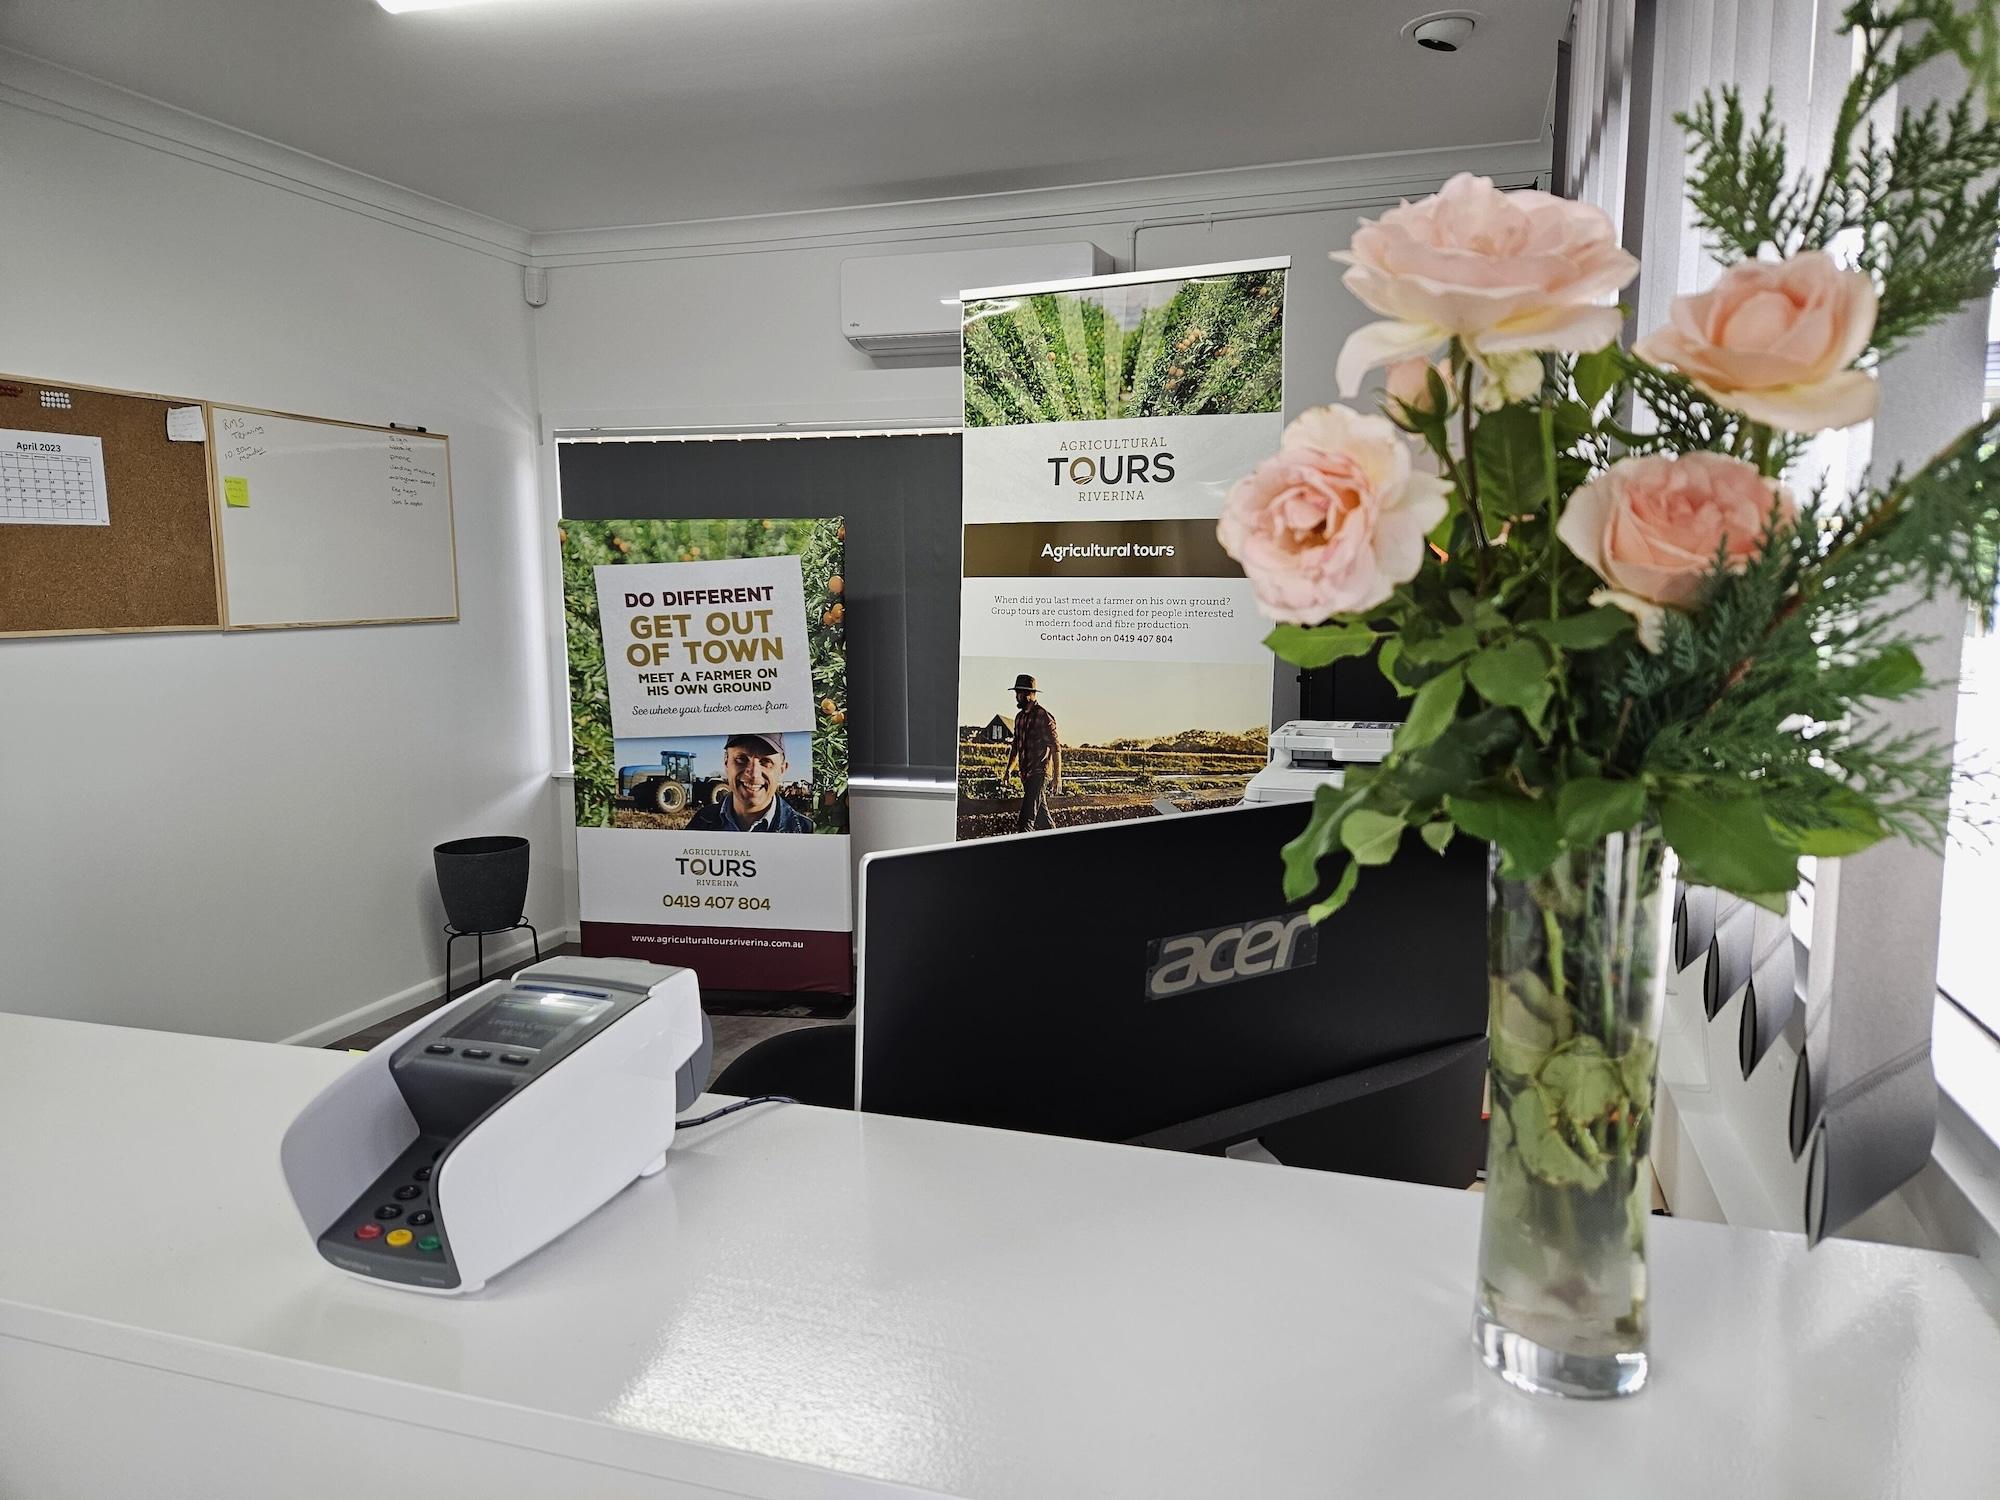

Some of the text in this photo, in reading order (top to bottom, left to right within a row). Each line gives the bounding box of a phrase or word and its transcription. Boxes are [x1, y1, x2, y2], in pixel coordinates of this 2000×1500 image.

[16, 442, 61, 452] April 2023
[1060, 436, 1168, 451] AGRICULTURAL
[1047, 452, 1175, 486] TOURS
[1078, 490, 1145, 502] RIVERINA
[1040, 542, 1175, 562] Agricultural tours
[624, 585, 774, 608] DO DIFFERENT
[994, 595, 1018, 604] When
[1020, 595, 1033, 604] did
[1035, 597, 1052, 605] you
[1054, 596, 1069, 604] last
[1071, 597, 1094, 605] meet
[1103, 596, 1134, 605] farmer
[1150, 596, 1164, 605] his
[1189, 597, 1231, 608] ground?
[991, 606, 1234, 619] Group tours are custom designed for people interested
[630, 609, 774, 640] GET OUT
[1025, 619, 1034, 627] in
[1036, 619, 1071, 627] modern
[1072, 619, 1093, 628] food
[1094, 619, 1112, 628] and
[1114, 620, 1135, 628] fibre
[1040, 632, 1074, 641] Contact
[1076, 633, 1098, 642] John
[1113, 634, 1135, 643] 0419
[1136, 634, 1154, 643] 407
[1155, 635, 1173, 643] 804
[626, 636, 784, 667] OF TOWN
[638, 667, 778, 684] MEET A FARMER ON
[647, 681, 771, 696] HIS OWN GROUND
[631, 700, 789, 717] See where your tucker comes from
[682, 848, 751, 857] AGRICULTURAL
[675, 857, 757, 878] TOURS
[696, 879, 739, 887] RIVERINA
[662, 894, 771, 911] 0419 407 804
[631, 934, 804, 949] www.agriculturaltoursriverina.com.au
[1151, 913, 1312, 994] acer
